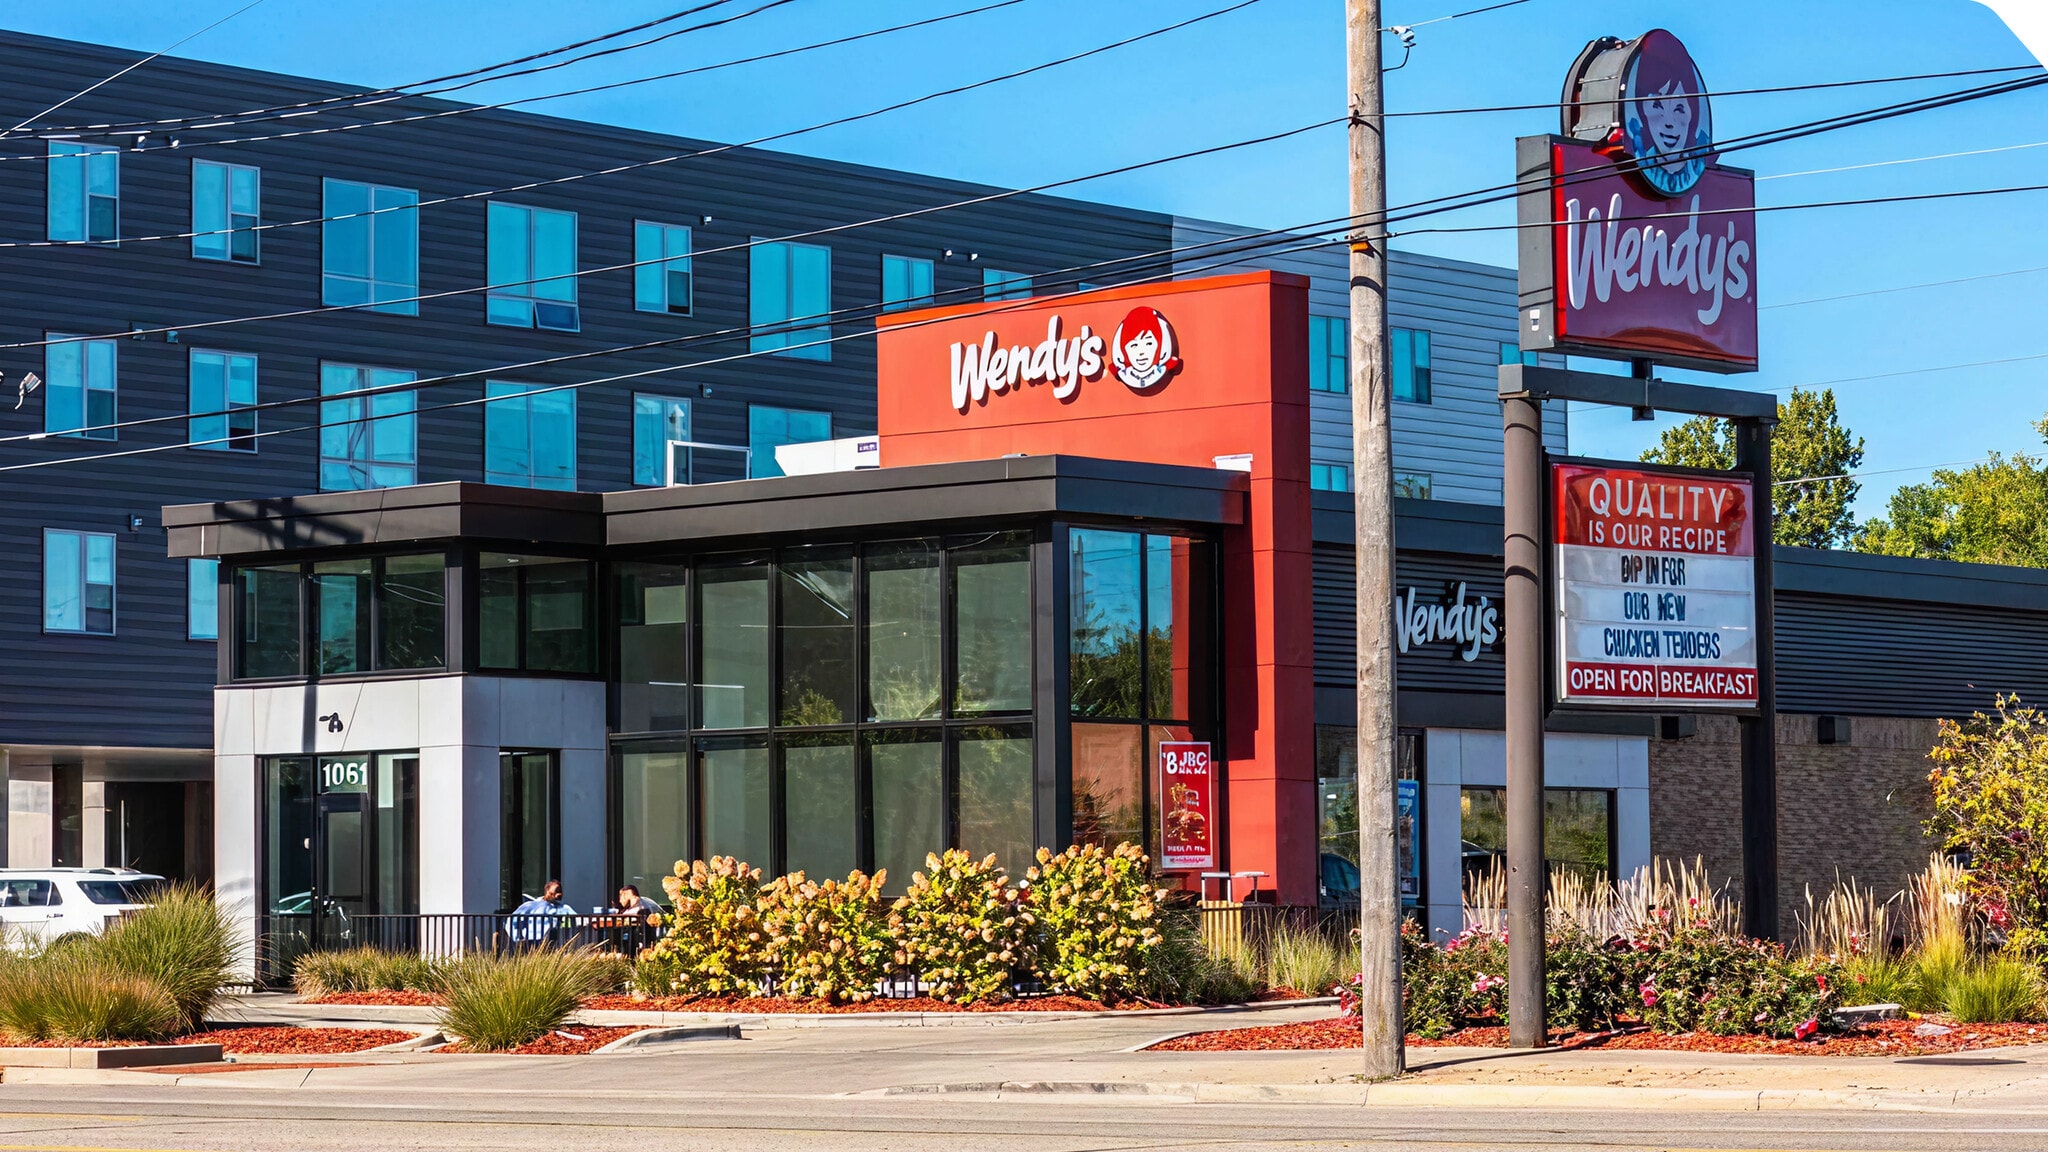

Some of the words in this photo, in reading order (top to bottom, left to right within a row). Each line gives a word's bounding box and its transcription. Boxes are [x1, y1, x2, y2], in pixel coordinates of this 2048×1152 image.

[1566, 193, 1750, 326] Wendy's
[950, 315, 1103, 410] Wendy's
[1589, 478, 1728, 524] QUALITY
[1588, 520, 1605, 544] IS
[1612, 523, 1653, 548] OUR
[1659, 526, 1728, 553] RECIPE
[1621, 555, 1642, 583] DIP
[1645, 556, 1659, 584] IN
[1662, 557, 1686, 586] FOR
[1624, 591, 1649, 620] OUR
[1657, 592, 1686, 621] NEW
[1604, 628, 1660, 658] CHICKEN
[1663, 630, 1721, 659] TENDERS
[1571, 667, 1616, 691] OPEN
[1621, 669, 1654, 692] FOR
[1661, 672, 1754, 695] BREAKFAST
[322, 762, 368, 787] 1061
